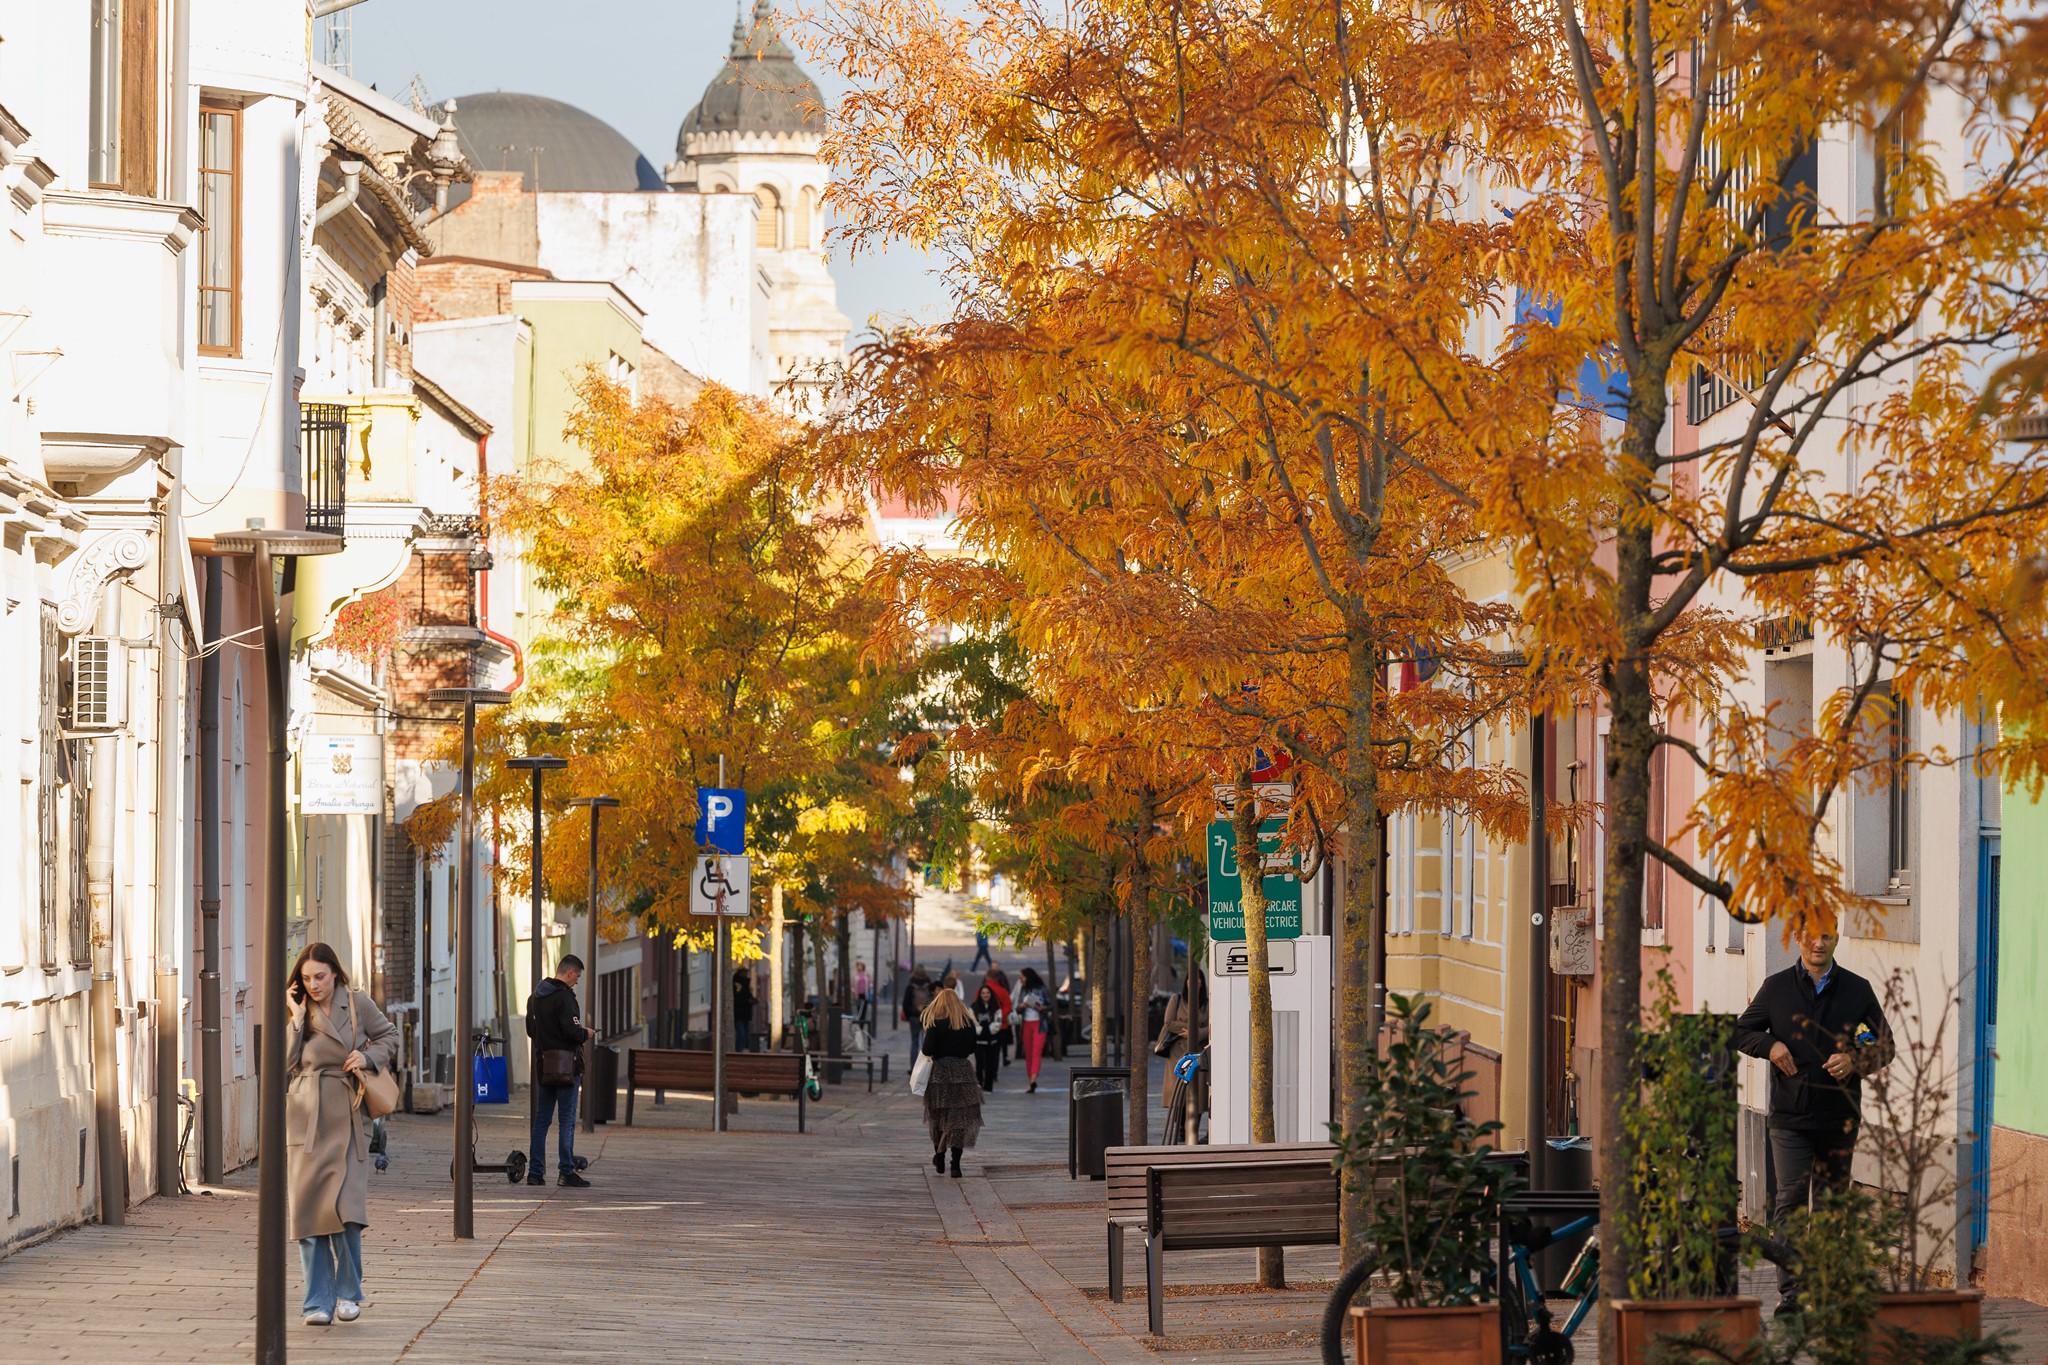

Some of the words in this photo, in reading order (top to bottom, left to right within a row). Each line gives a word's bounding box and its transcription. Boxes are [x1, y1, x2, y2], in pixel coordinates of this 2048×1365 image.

[707, 795, 733, 832] P
[1212, 917, 1246, 929] VEHICUL
[1265, 916, 1299, 928] ECTRICE
